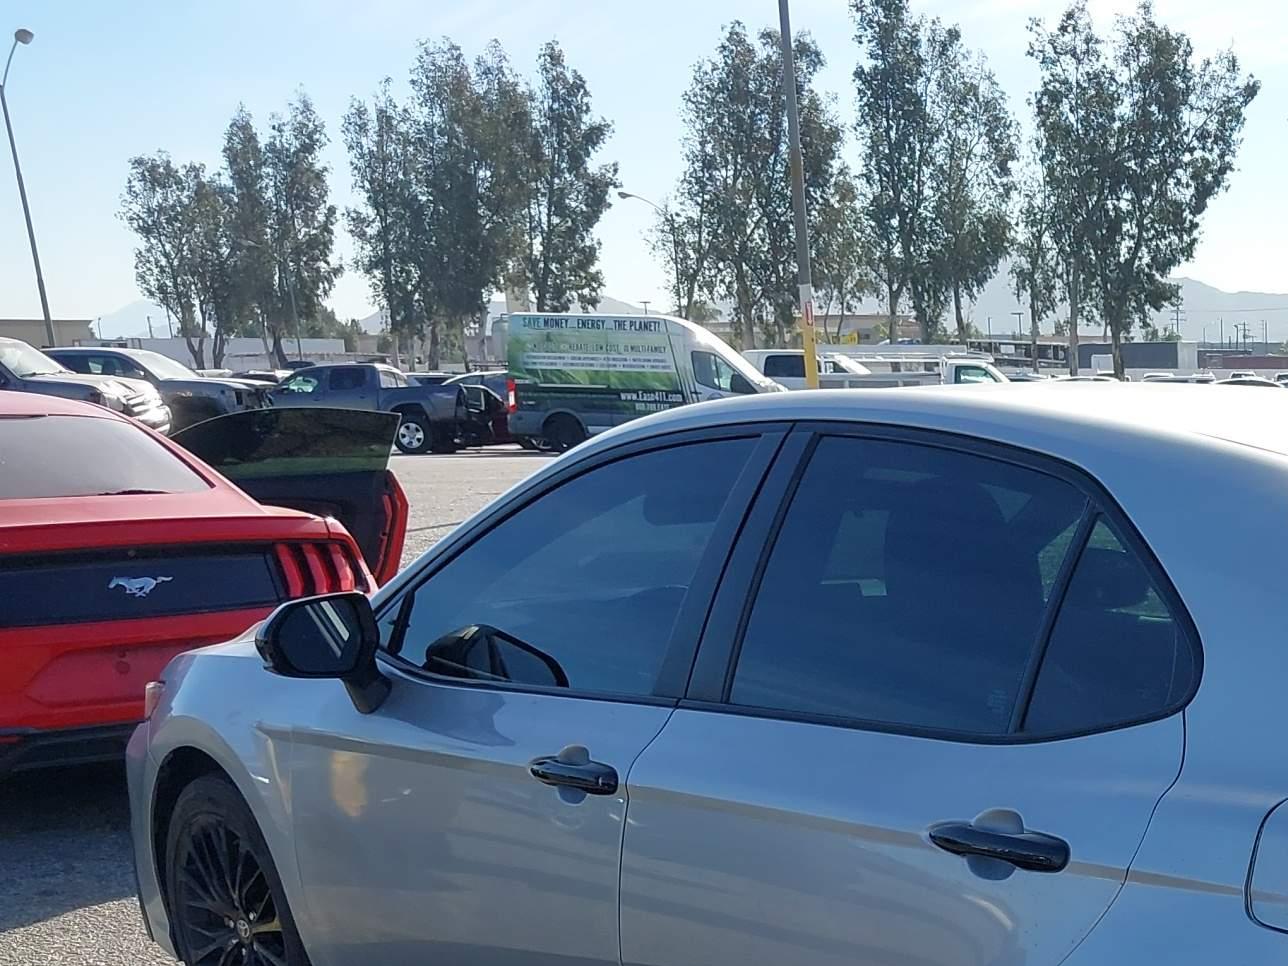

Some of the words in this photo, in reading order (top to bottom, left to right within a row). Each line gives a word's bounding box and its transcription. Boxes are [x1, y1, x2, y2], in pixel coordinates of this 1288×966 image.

[522, 317, 541, 328] SAVE
[613, 319, 628, 331] THE
[629, 320, 660, 332] PLANET!
